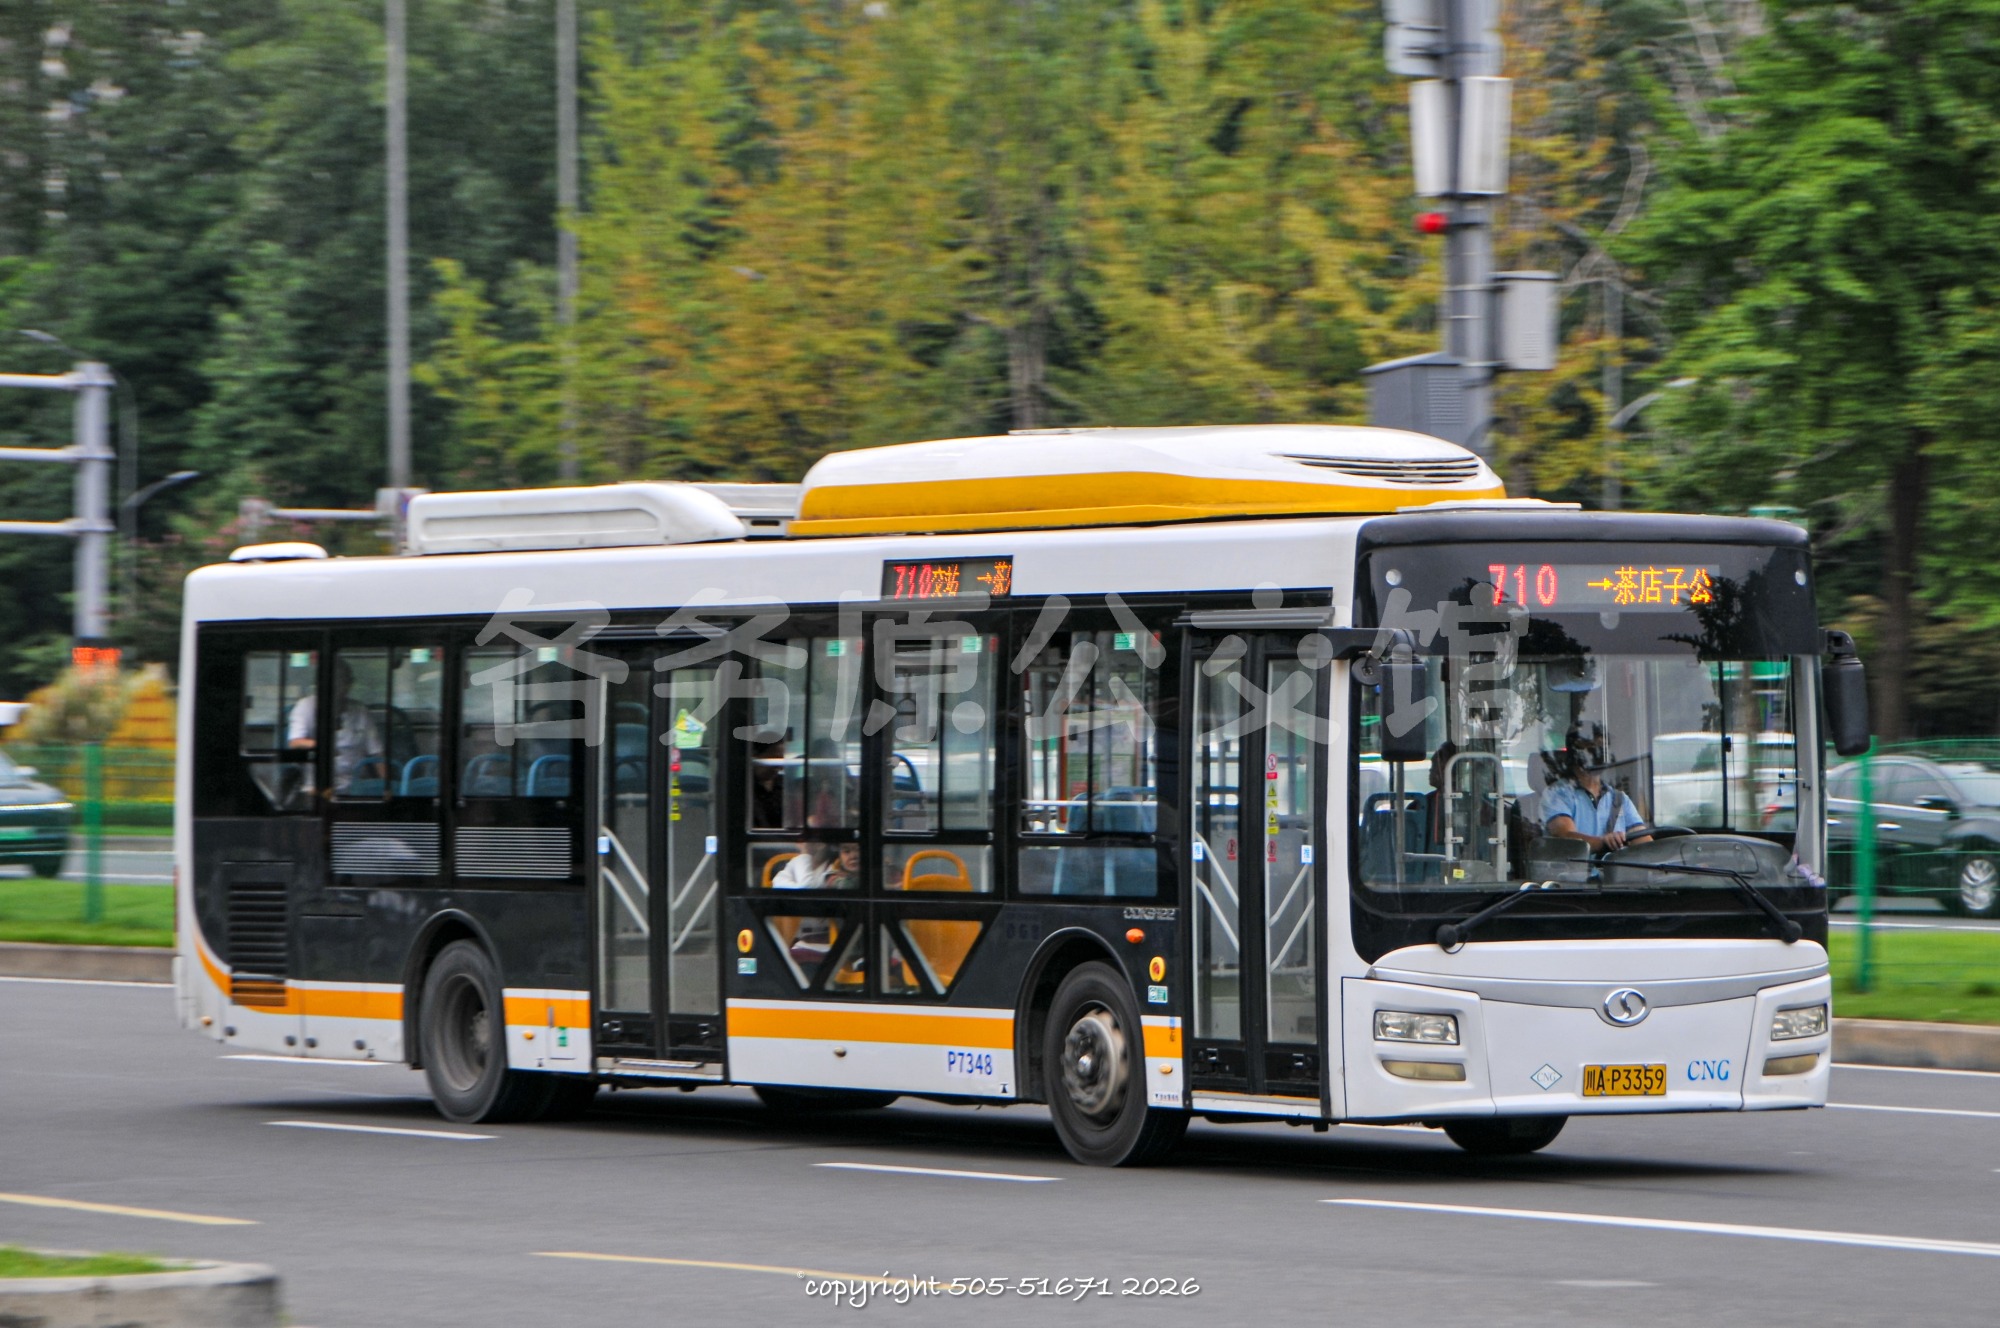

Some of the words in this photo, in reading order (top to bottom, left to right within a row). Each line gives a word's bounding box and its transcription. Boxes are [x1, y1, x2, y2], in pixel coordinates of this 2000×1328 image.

[893, 564, 932, 599] 710
[1488, 564, 1557, 606] 710
[1612, 566, 1712, 604] 茶店子公
[948, 1051, 993, 1076] P7348
[1536, 1072, 1556, 1083] CNG
[1687, 1060, 1730, 1081] CNG
